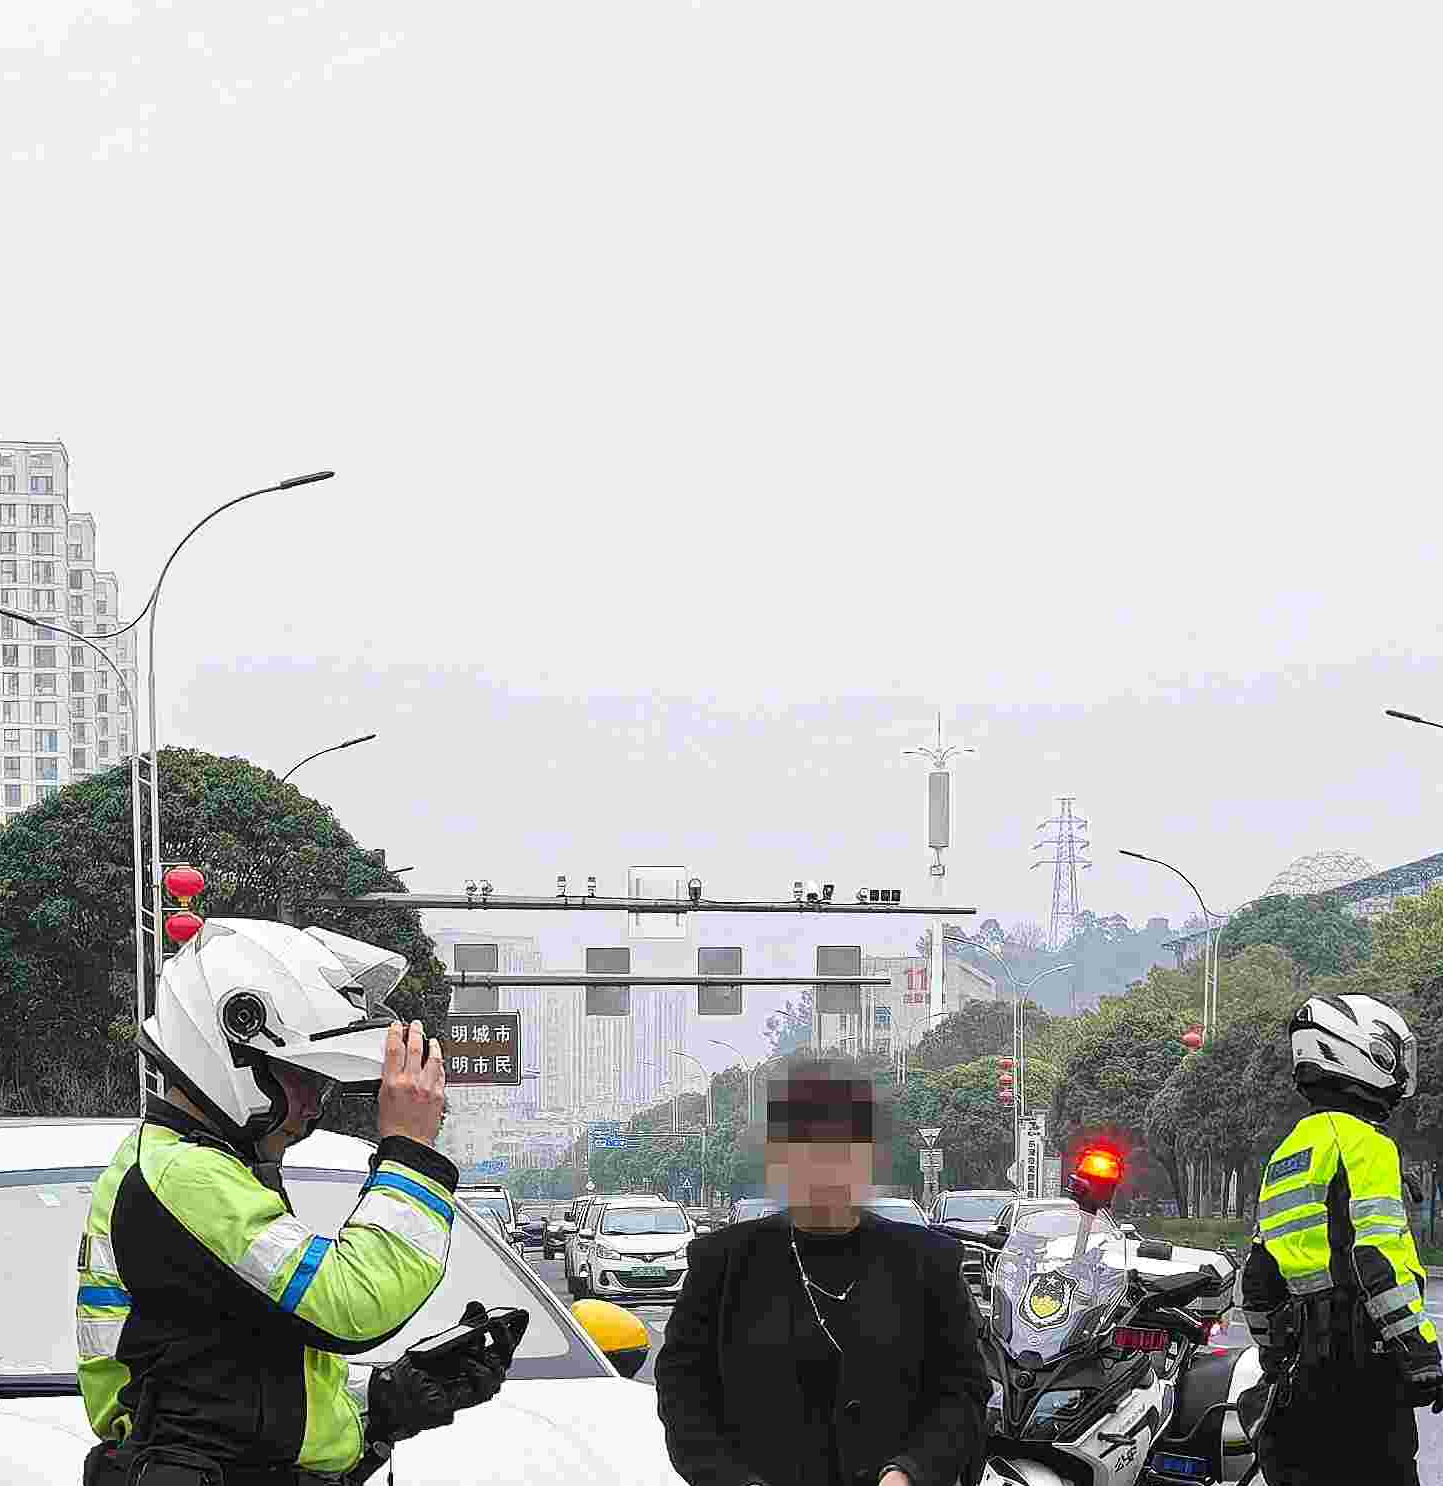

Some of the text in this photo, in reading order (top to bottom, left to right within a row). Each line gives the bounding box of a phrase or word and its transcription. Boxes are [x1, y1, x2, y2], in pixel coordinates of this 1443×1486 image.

[451, 1025, 512, 1043] 明城市
[451, 1056, 512, 1074] 明市民
